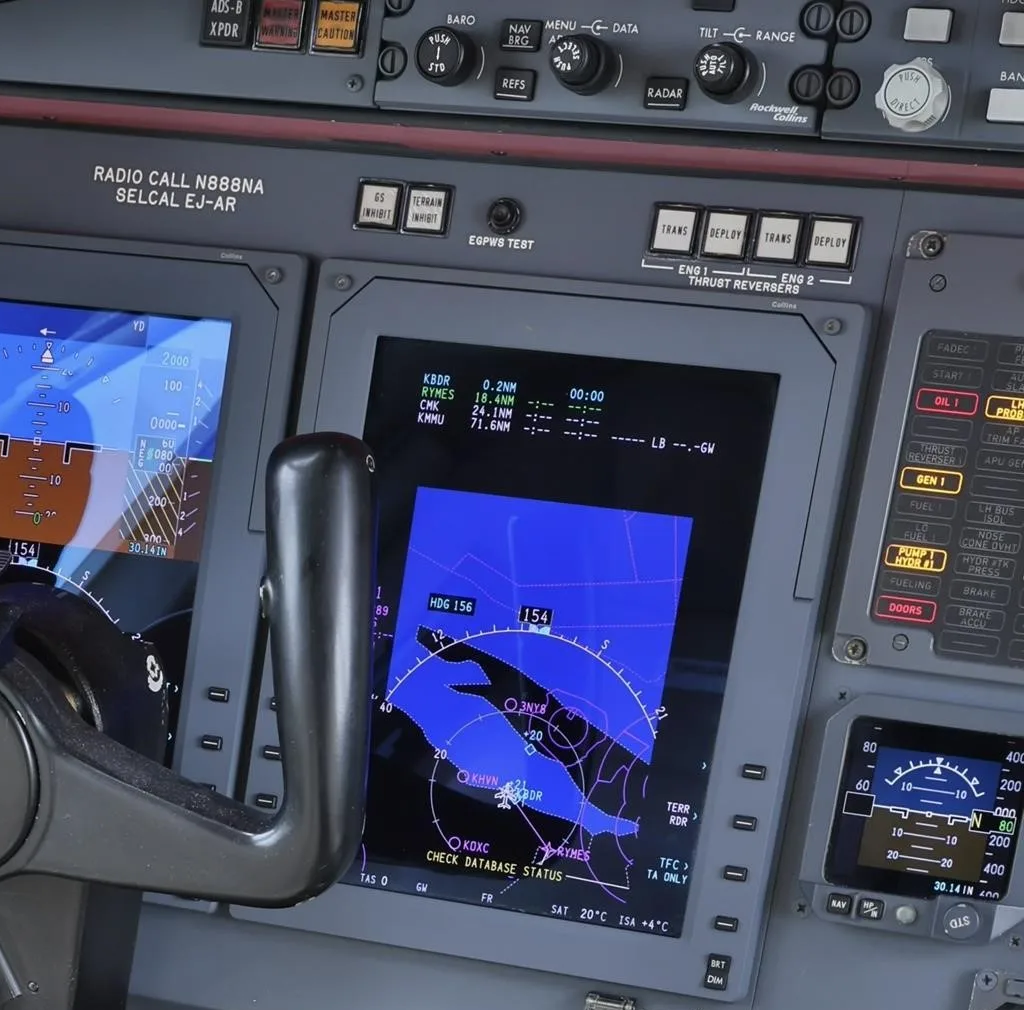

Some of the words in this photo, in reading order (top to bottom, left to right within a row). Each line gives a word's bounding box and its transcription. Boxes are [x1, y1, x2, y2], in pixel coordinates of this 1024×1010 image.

[211, 0, 243, 14] ADS-B
[320, 10, 356, 21] MASTER
[447, 14, 475, 25] BARO
[209, 22, 239, 37] XPDR
[509, 24, 531, 34] NAV
[545, 20, 576, 31] MENU
[613, 22, 639, 34] DATA
[317, 28, 354, 40] CAUTION
[700, 28, 718, 38] TILT
[756, 31, 796, 42] RANGE
[428, 34, 451, 45] PUSH
[508, 35, 529, 45] BRG
[428, 63, 446, 73] STD
[899, 71, 921, 83] PUSH
[503, 79, 526, 89] REFS
[648, 88, 683, 98] RADAR
[750, 103, 798, 114] Rockwell
[890, 98, 920, 111] DIRECT
[773, 113, 808, 123] Collins
[94, 166, 143, 184] RADIO
[149, 171, 190, 189] CALL
[195, 174, 264, 194] N888NA
[116, 188, 179, 208] SELCAL
[185, 193, 237, 212] EJ-AR
[375, 192, 385, 202] GS
[413, 196, 442, 207] TERRAIN
[363, 208, 392, 219] INHIBIT
[412, 213, 437, 223] INHIBIT
[662, 224, 688, 236] TRANS
[710, 228, 742, 240] DEPLOY
[469, 236, 504, 247] EGPWS
[508, 239, 535, 250] TEST
[765, 232, 792, 244] TRANS
[814, 236, 846, 248] DEPLOY
[678, 265, 701, 275] ENG
[689, 276, 731, 289] THRUST
[734, 280, 800, 294] REVERSERS
[782, 274, 804, 285] ENG
[807, 276, 814, 285] 2
[937, 343, 969, 354] FADEC
[424, 373, 450, 386] KBDR
[483, 379, 517, 392] 0.2NM
[422, 387, 455, 400] RYMES
[475, 392, 515, 405] 18.4NM
[569, 387, 605, 402] 00:00
[935, 396, 950, 407] OIL
[420, 400, 439, 411] CMK
[472, 405, 513, 418] 24.1NM
[418, 412, 444, 425] KMMU
[471, 418, 510, 432] 71.6NM
[917, 474, 938, 485] GEN
[940, 477, 945, 487] 1
[14, 542, 36, 556] 154
[898, 548, 926, 557] PUMP
[896, 556, 921, 567] HYDR
[963, 587, 996, 597] BRAKE
[430, 596, 450, 609] HDG
[453, 599, 473, 612] 156
[889, 603, 923, 615] DOORS
[524, 608, 548, 623] 154
[863, 741, 877, 753] 80
[472, 773, 499, 785] KHVN
[1000, 780, 1021, 791] 200
[667, 802, 690, 814] TERR
[669, 816, 688, 827] RDR
[557, 847, 590, 861] RYMES
[426, 850, 458, 865] CHECK
[465, 856, 517, 875] DATABASE
[523, 866, 563, 881] STATUS
[659, 857, 679, 869] TFC
[984, 864, 1005, 875] 400
[647, 869, 659, 879] TA
[663, 872, 688, 884] ONLY
[934, 882, 961, 893] 30.14
[963, 884, 973, 894] IN
[832, 900, 847, 909] NAV
[551, 904, 569, 916] SAT
[581, 908, 608, 921] 20°C
[619, 915, 636, 926] ISA
[950, 916, 971, 929] STD
[711, 960, 725, 969] BRT
[707, 975, 723, 984] DIM
